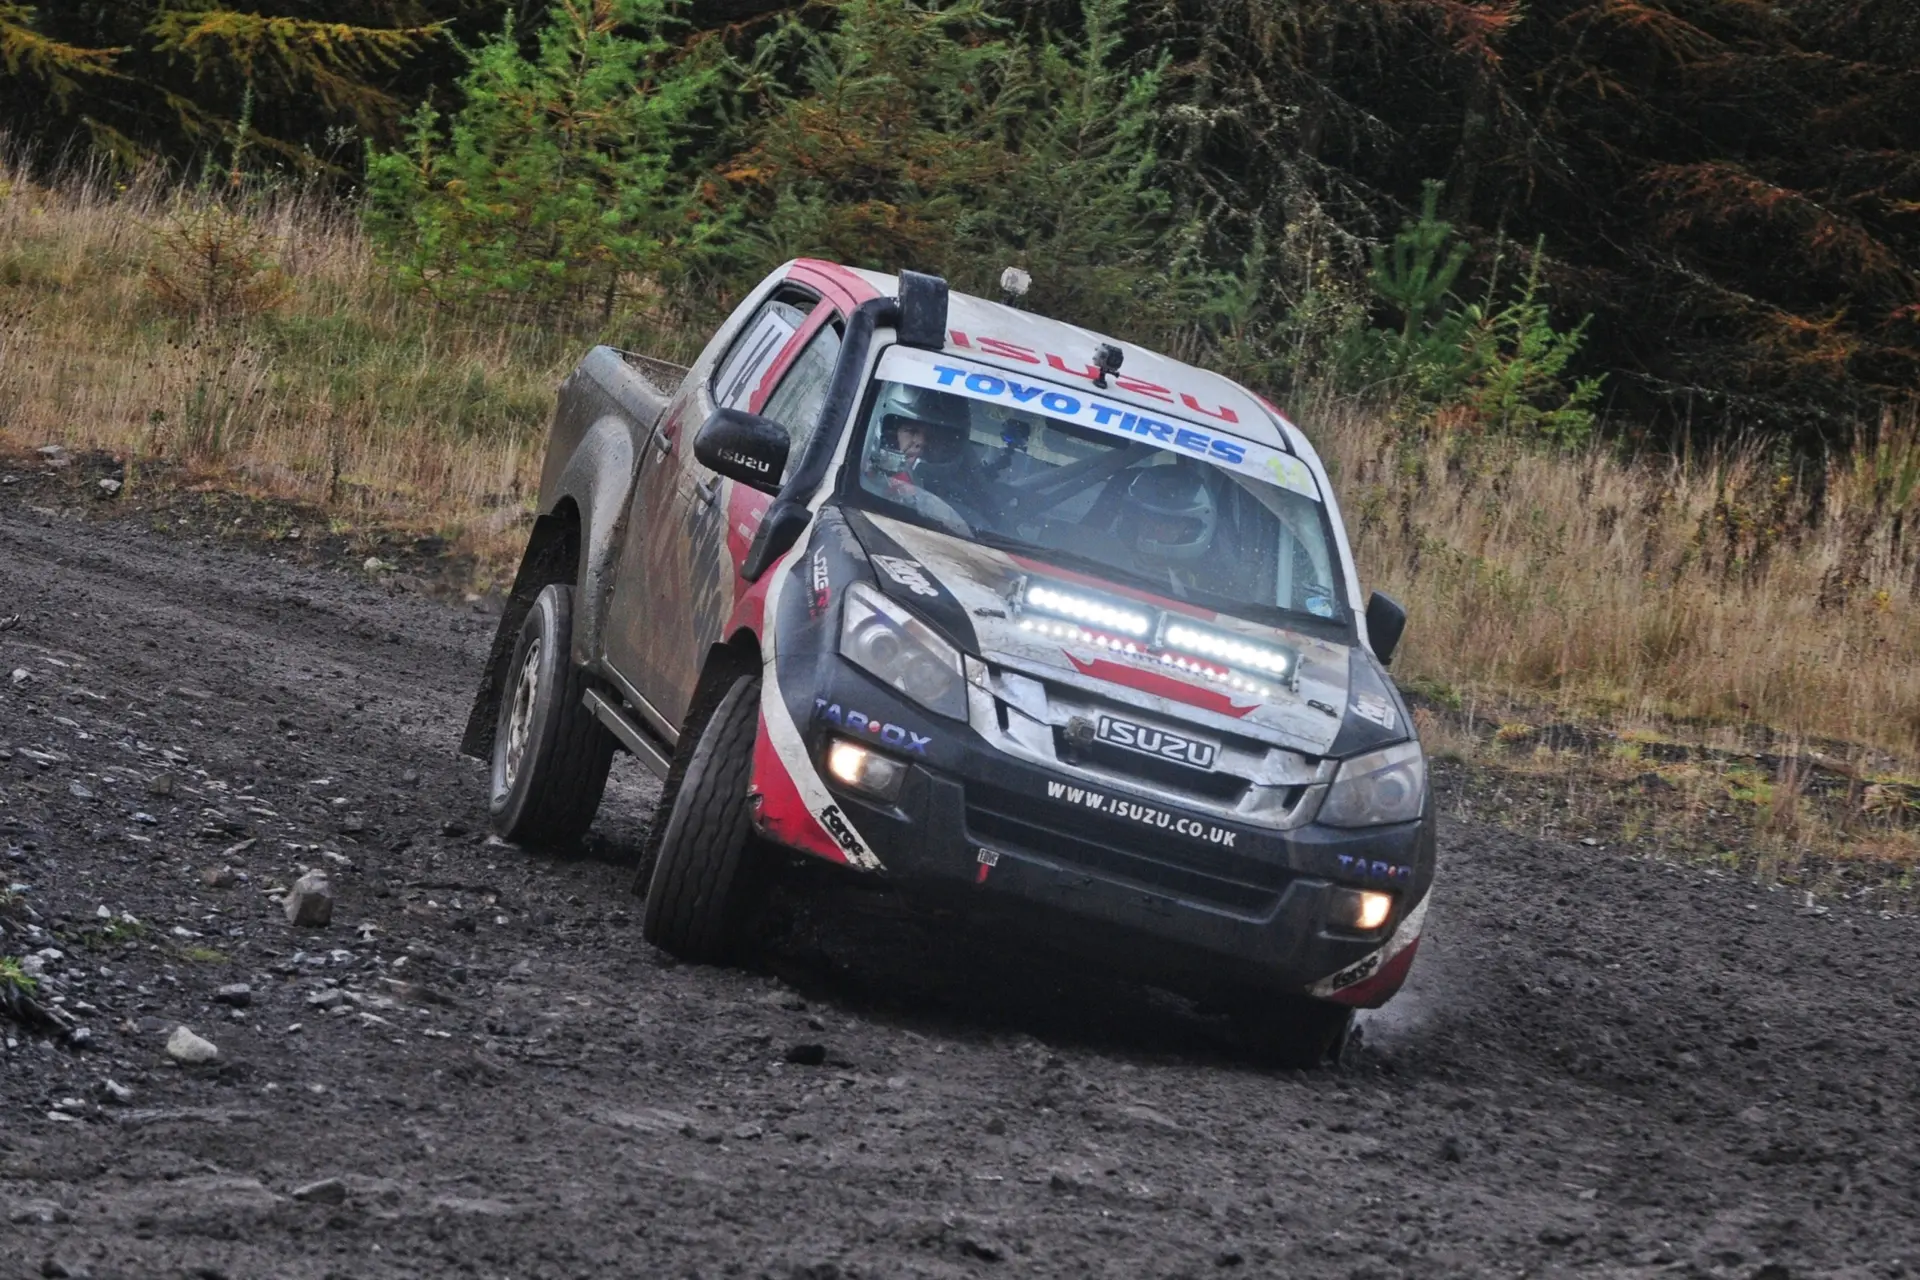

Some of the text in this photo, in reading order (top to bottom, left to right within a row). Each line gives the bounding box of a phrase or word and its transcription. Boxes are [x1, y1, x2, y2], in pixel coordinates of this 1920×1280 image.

[949, 329, 1239, 423] ISUZU
[717, 447, 770, 473] ISUZU
[1090, 402, 1246, 464] TIRES
[1100, 718, 1213, 766] ISUZU
[1047, 781, 1237, 848] WWW.ISUZU.CO.UK
